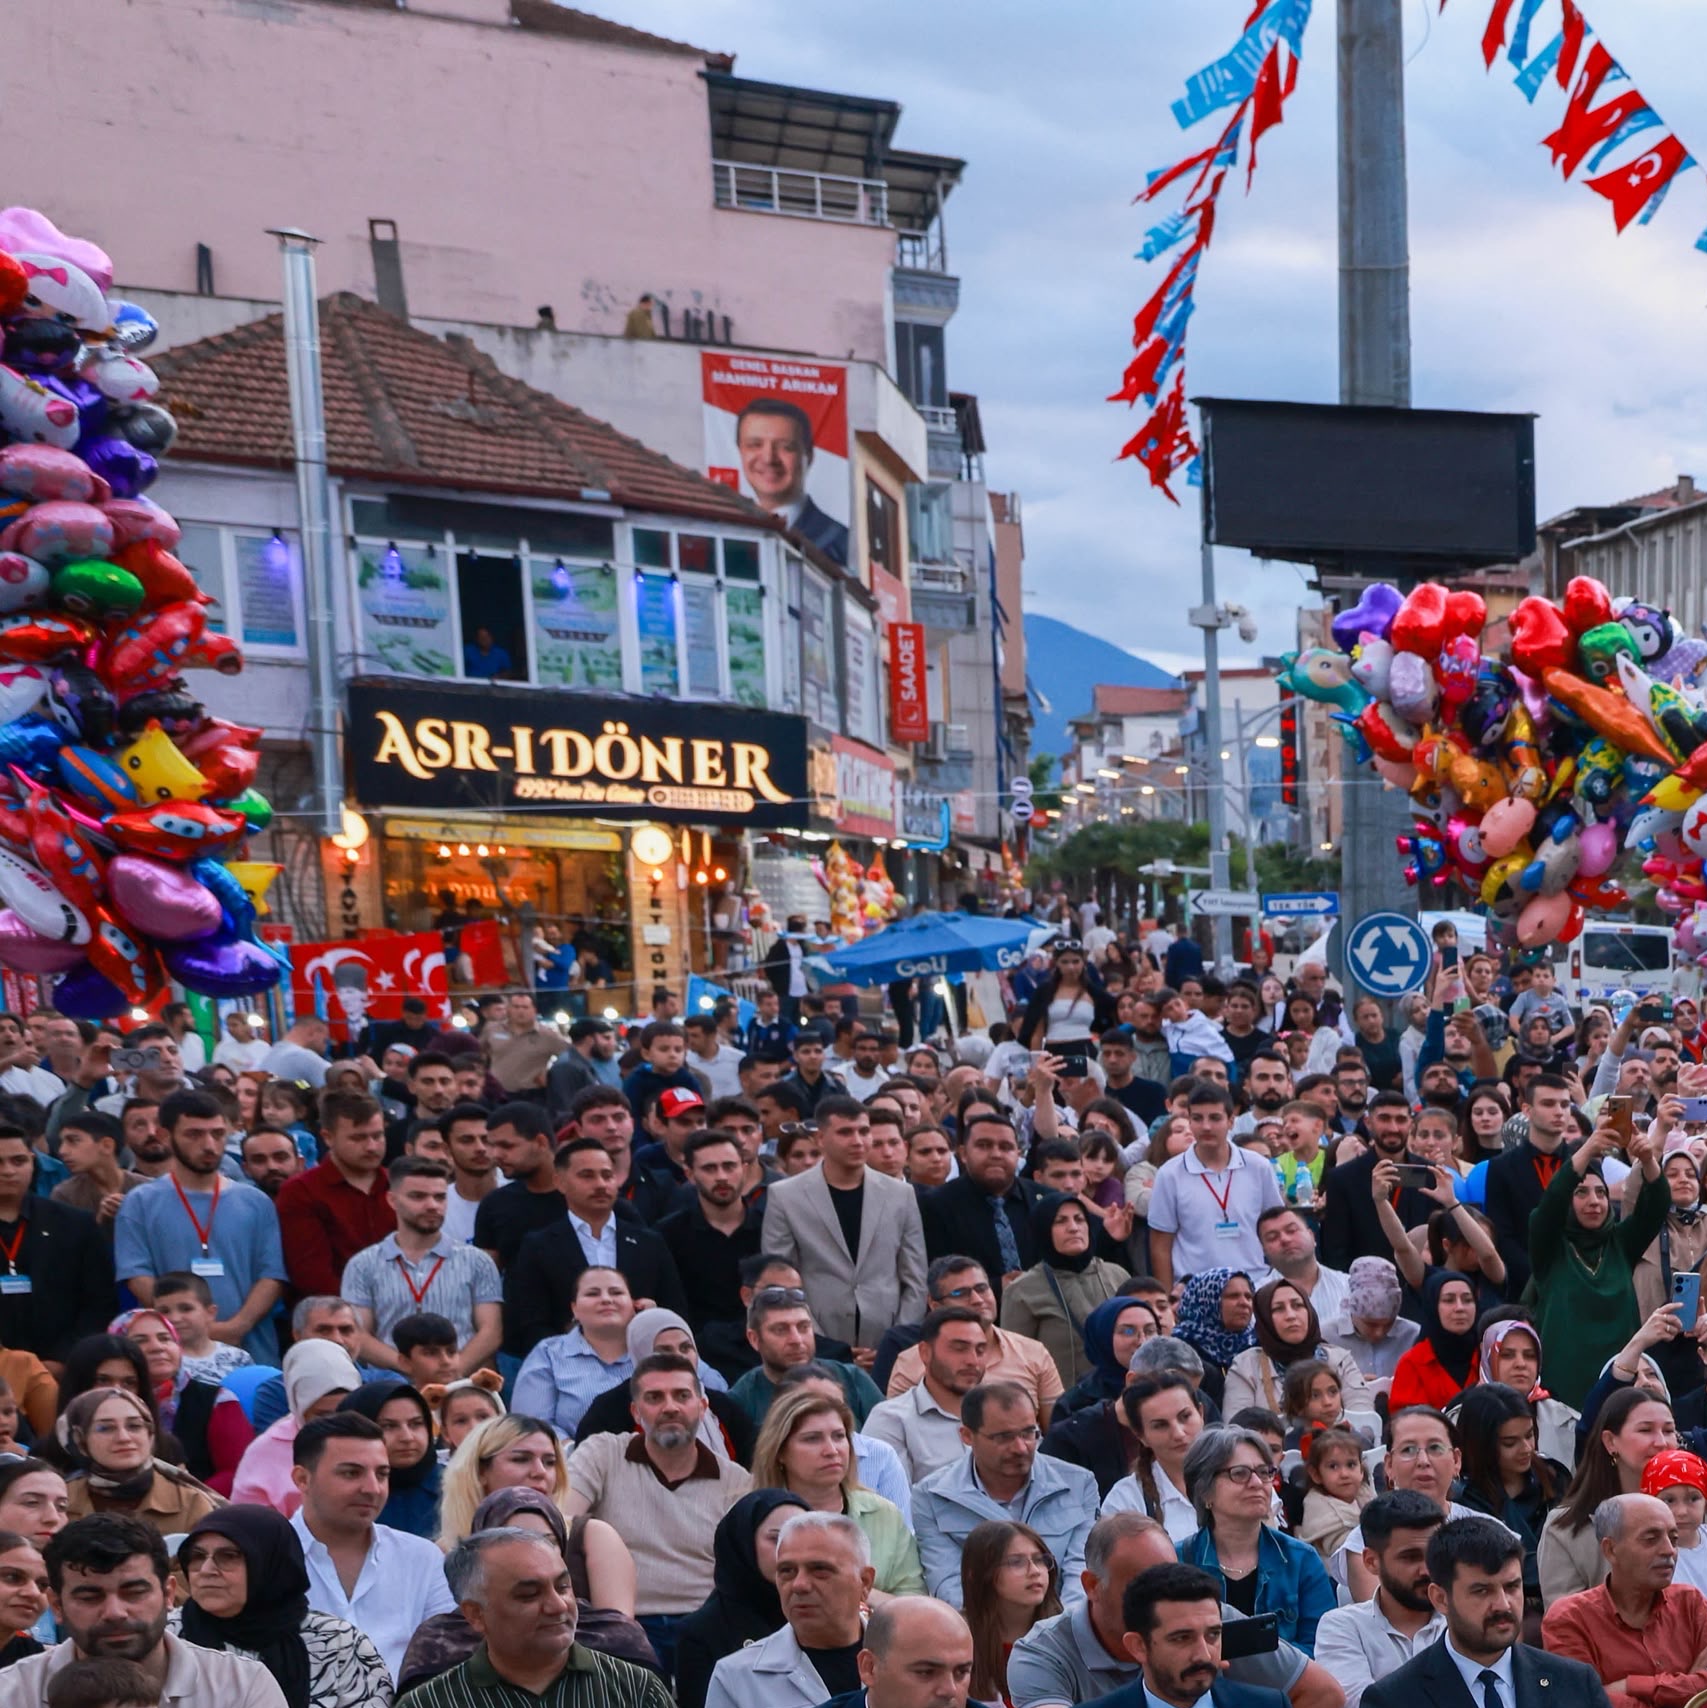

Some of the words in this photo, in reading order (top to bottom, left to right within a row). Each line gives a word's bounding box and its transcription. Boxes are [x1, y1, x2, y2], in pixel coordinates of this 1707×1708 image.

[711, 371, 777, 389] MAHMUT
[897, 627, 918, 702] SAADET
[373, 710, 537, 780] ASR-I
[538, 722, 791, 803] DÖNER
